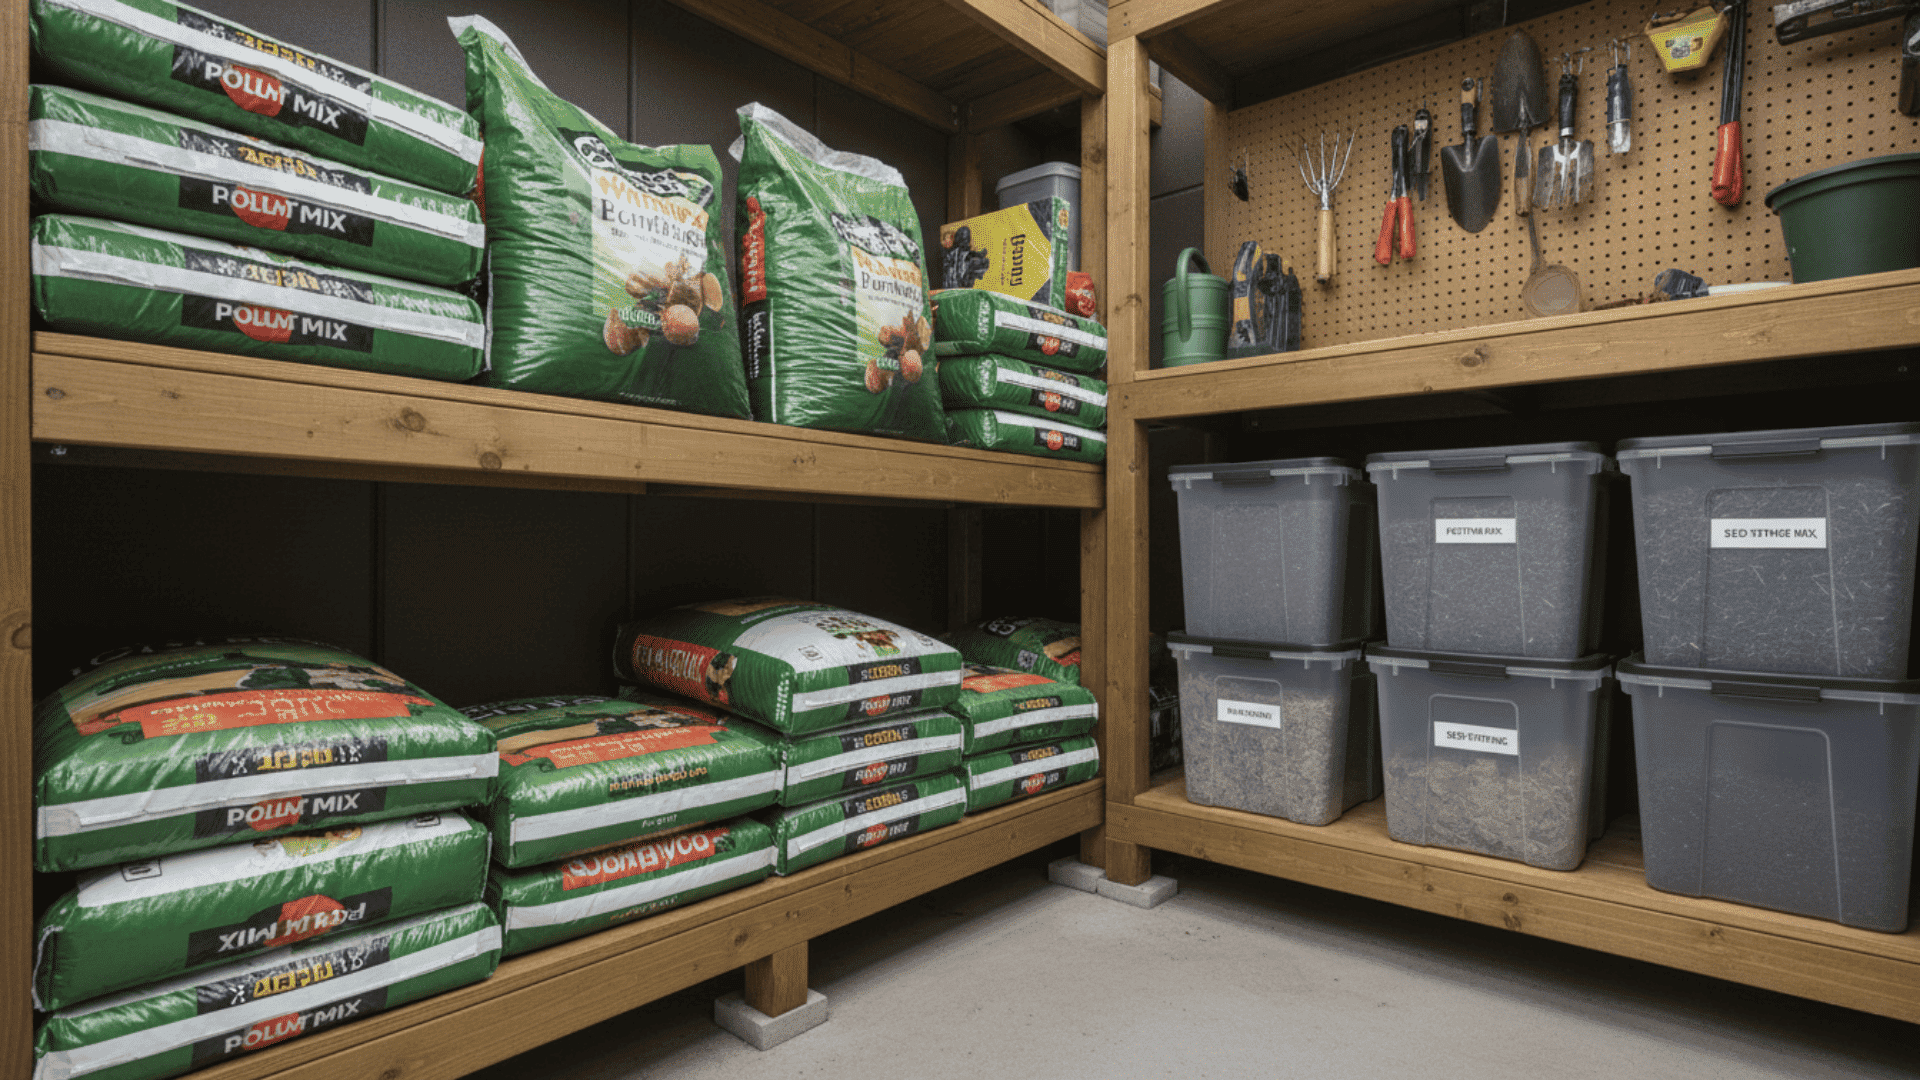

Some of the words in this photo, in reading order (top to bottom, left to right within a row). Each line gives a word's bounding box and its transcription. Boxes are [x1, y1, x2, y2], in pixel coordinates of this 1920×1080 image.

[293, 94, 342, 129] MIX
[301, 206, 347, 233] MIX
[302, 317, 347, 342] MIX
[312, 792, 361, 816] MIX
[313, 999, 361, 1027] MIX
